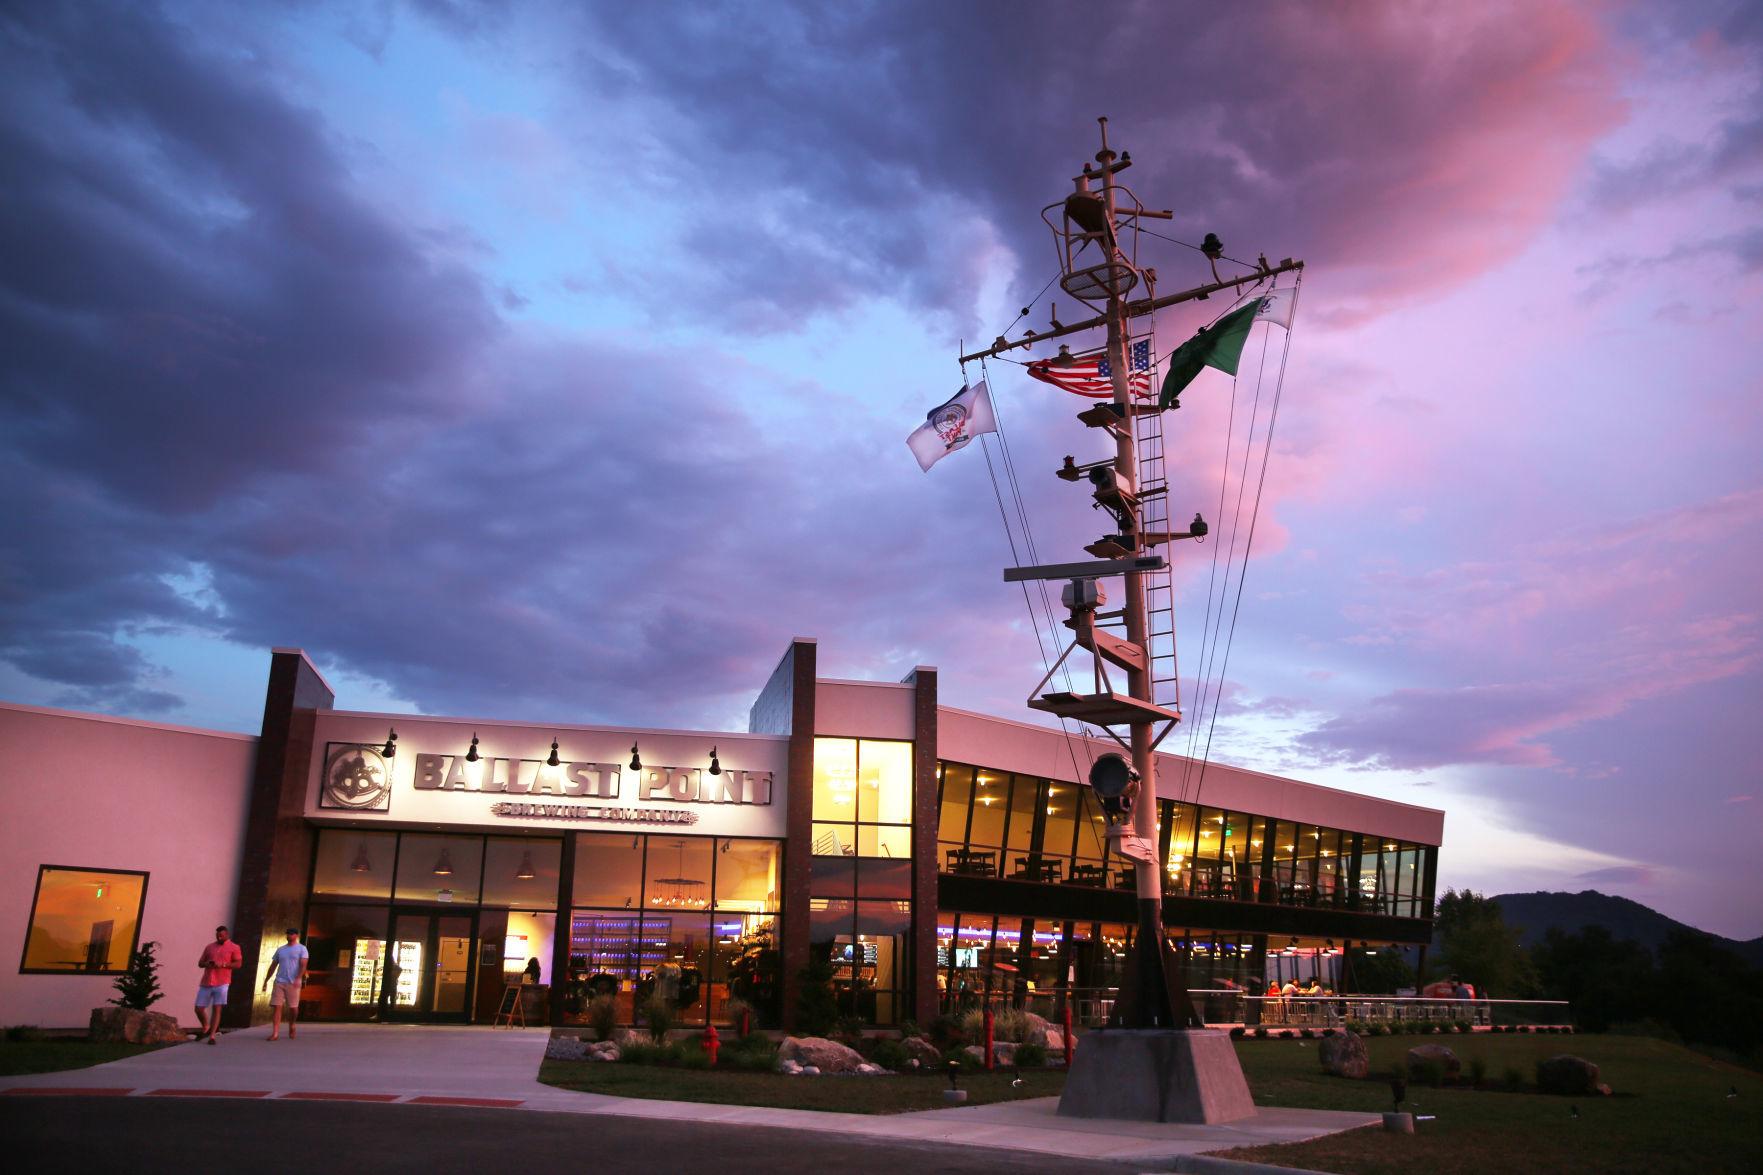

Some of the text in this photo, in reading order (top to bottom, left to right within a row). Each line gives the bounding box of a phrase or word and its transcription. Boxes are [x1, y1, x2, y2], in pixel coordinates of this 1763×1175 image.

[414, 753, 773, 805] BALLAST POINT
[510, 802, 680, 823] BREWING COMPANY
